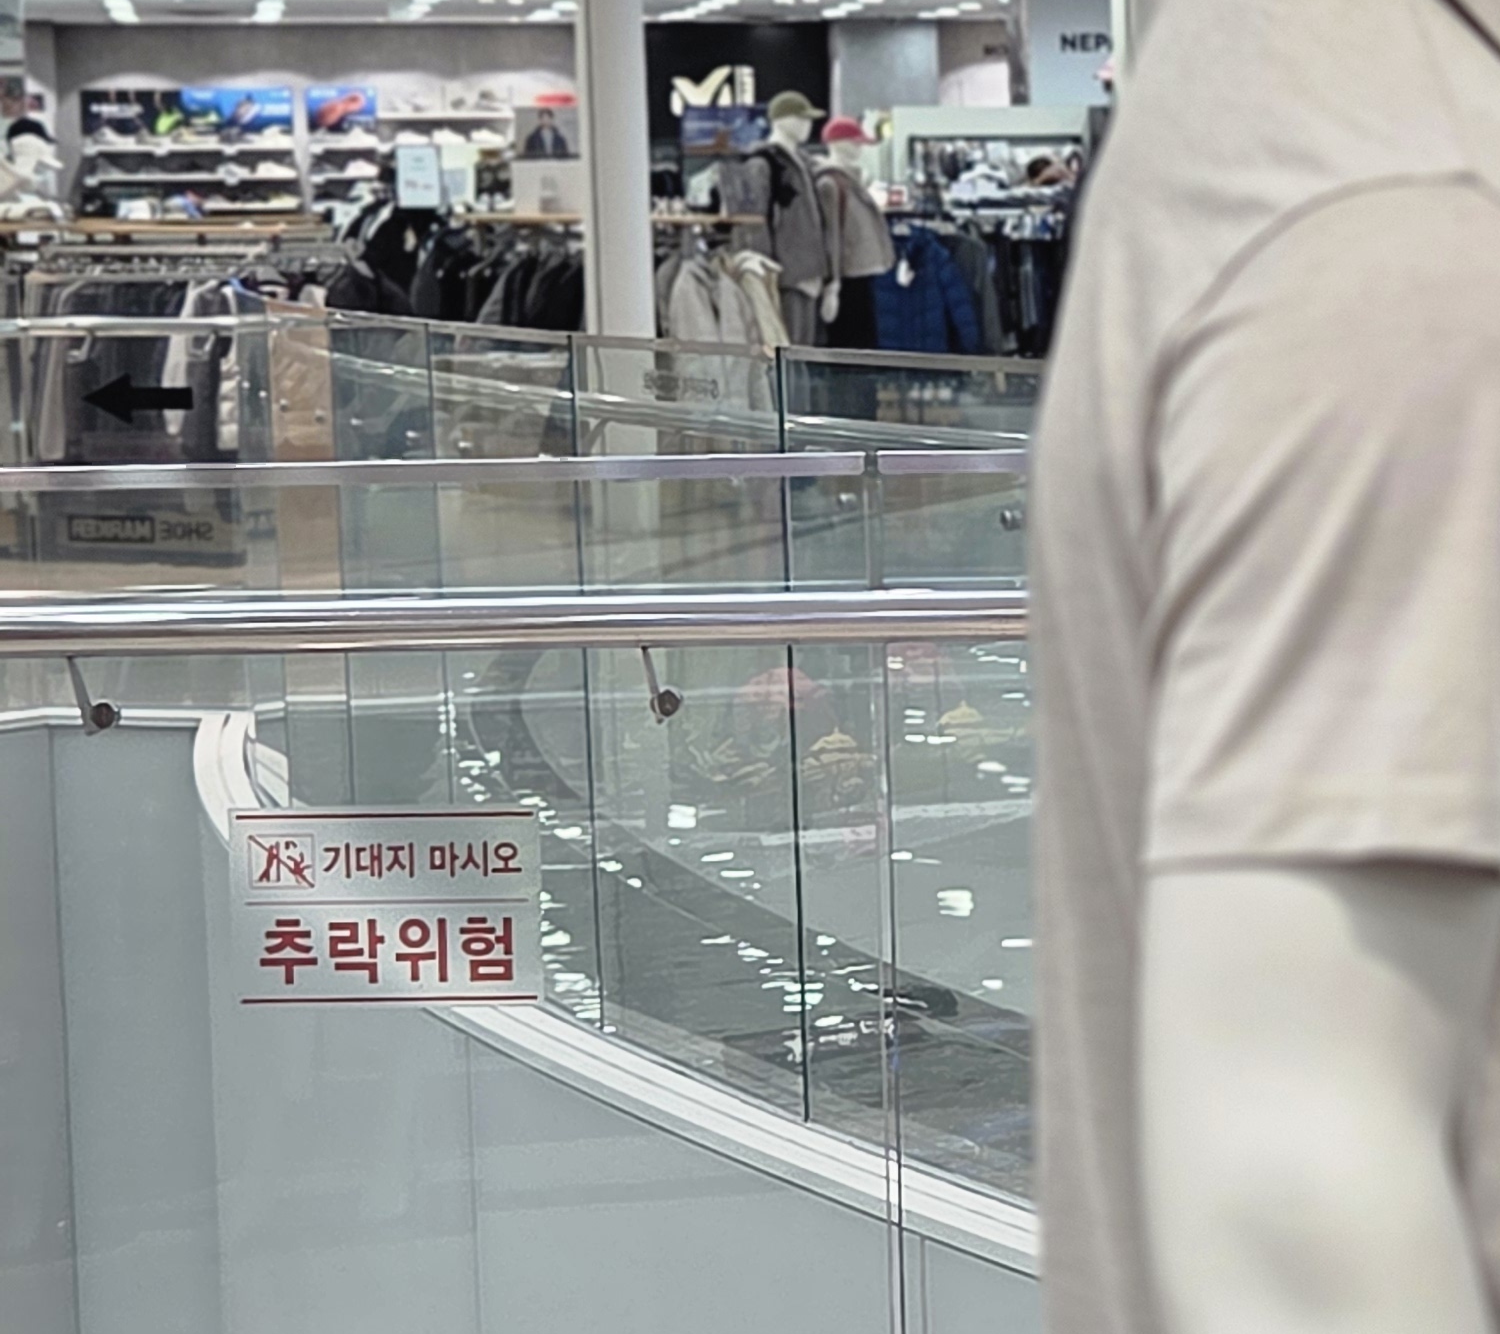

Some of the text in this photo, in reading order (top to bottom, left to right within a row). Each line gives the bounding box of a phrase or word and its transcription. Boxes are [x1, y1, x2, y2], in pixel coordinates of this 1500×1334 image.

[323, 840, 522, 879] 기대지 마시오
[259, 917, 514, 985] 추락위험
